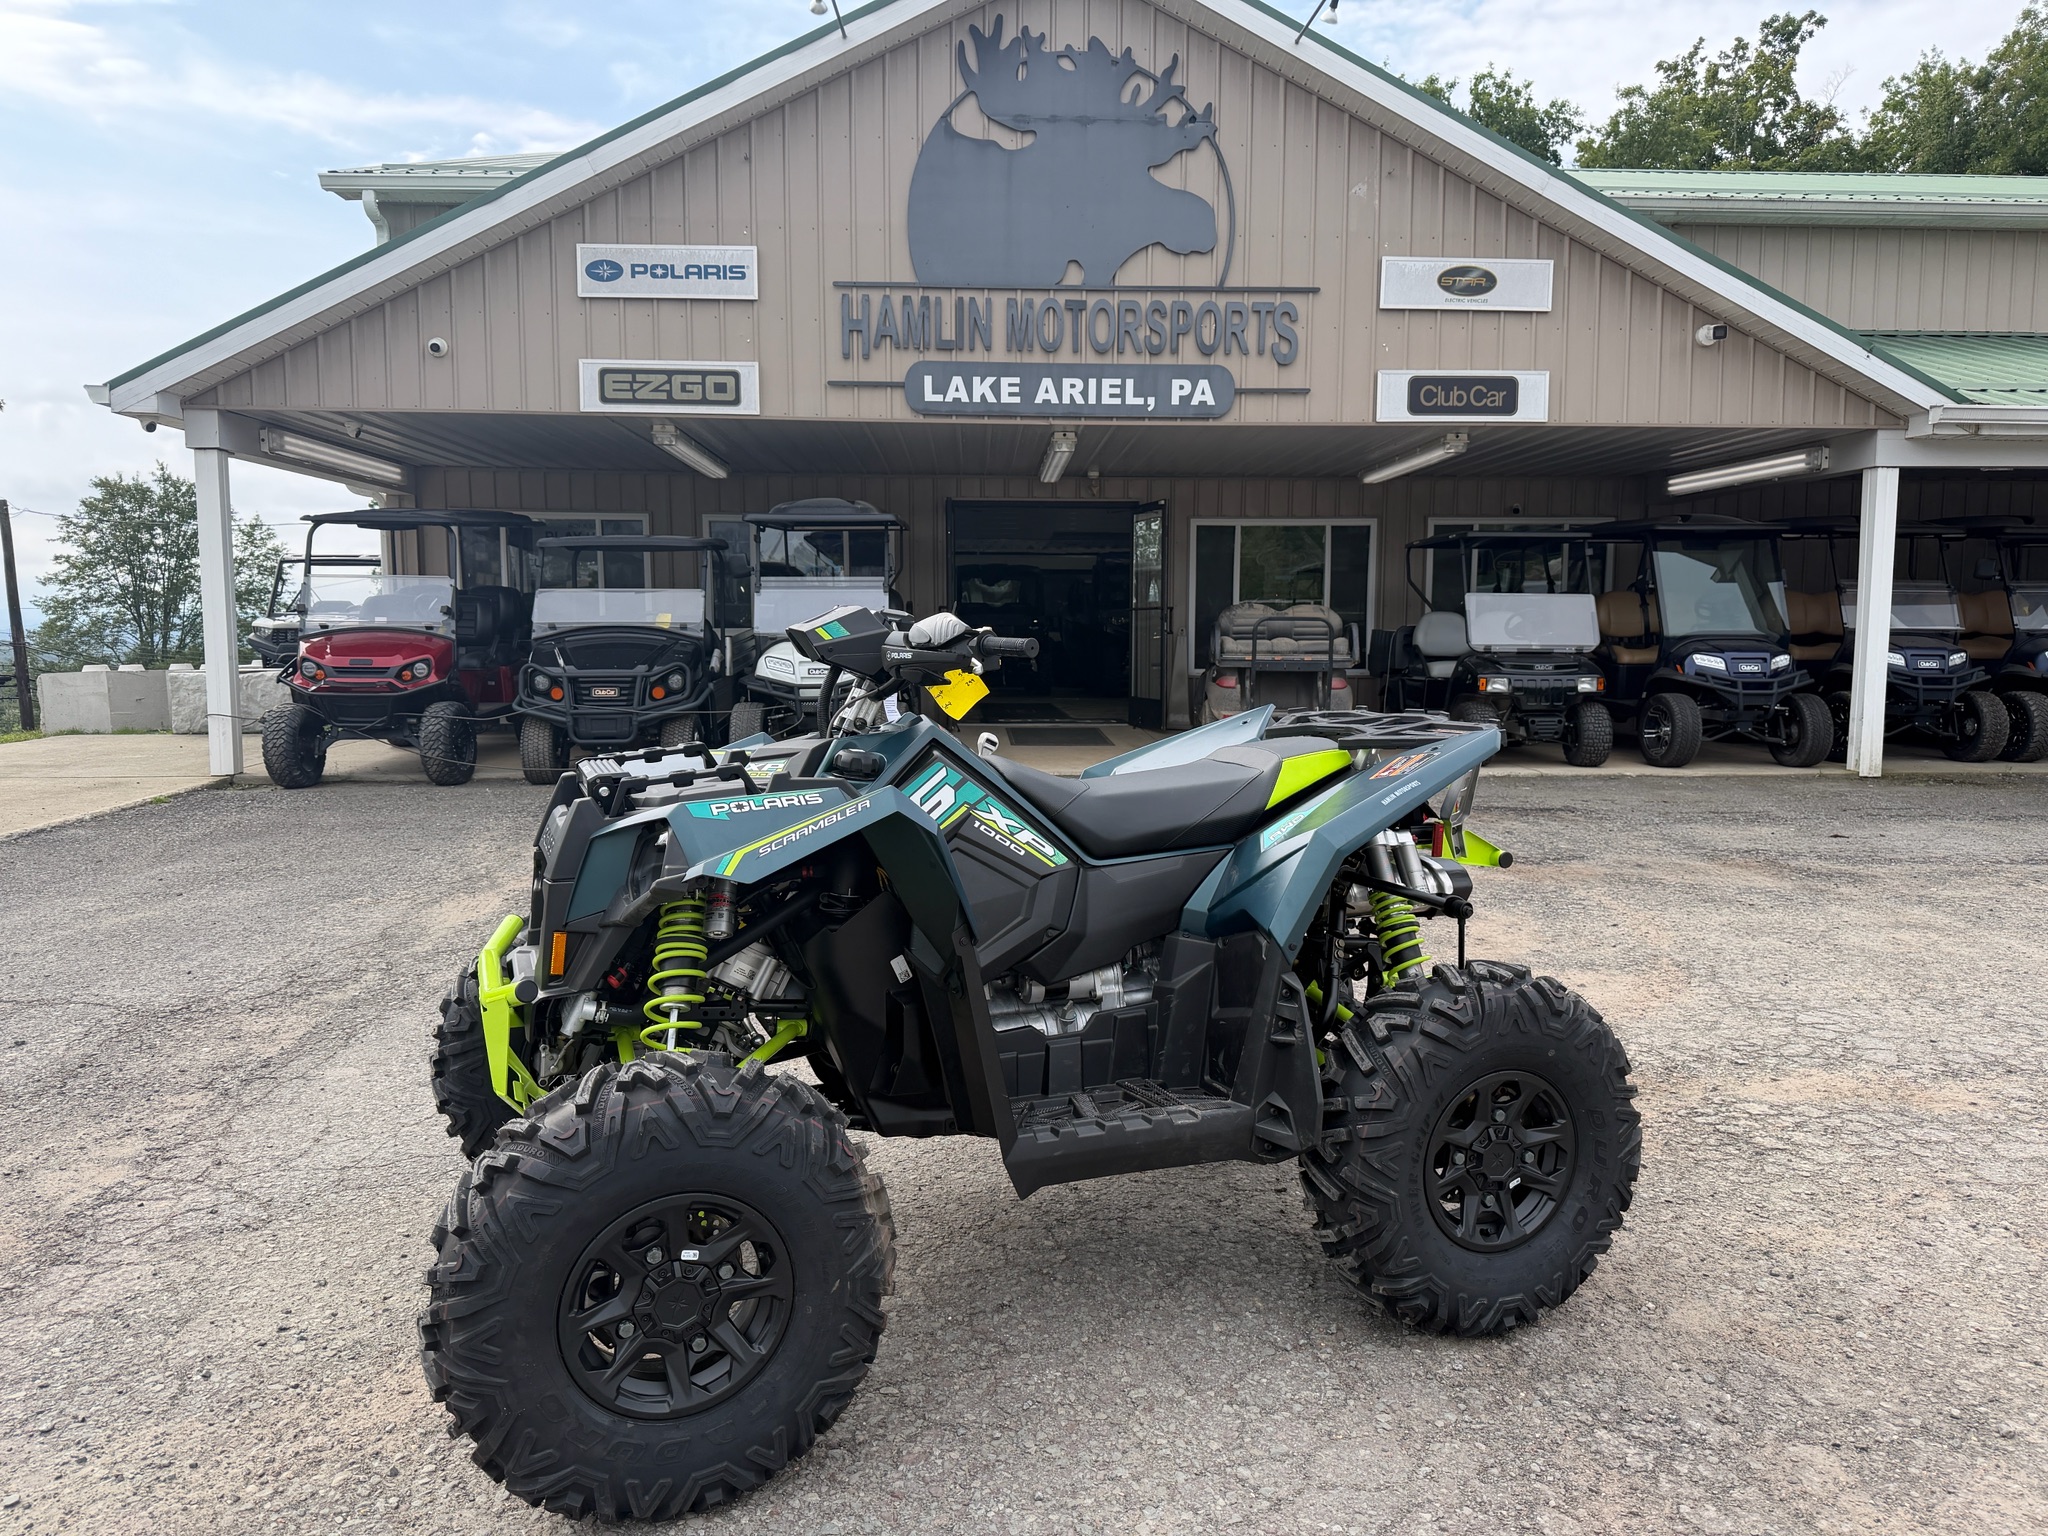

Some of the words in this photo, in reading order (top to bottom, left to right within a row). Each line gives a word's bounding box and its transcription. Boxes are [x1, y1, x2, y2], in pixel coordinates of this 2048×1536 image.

[630, 263, 747, 281] POLARIS
[1440, 276, 1486, 287] STAR
[841, 293, 992, 360] HAMLIN
[1006, 297, 1299, 366] MOTORSPORTS
[603, 373, 737, 401] EZGO
[923, 374, 1021, 403] LAKE
[1034, 377, 1156, 412] ARIEL,
[1171, 378, 1217, 406] PA
[710, 793, 824, 817] POLARIS
[757, 799, 872, 859] SCRAMBLER
[971, 803, 1057, 858] XP
[973, 819, 1026, 857] 1000
[1572, 1108, 1609, 1235] DURO
